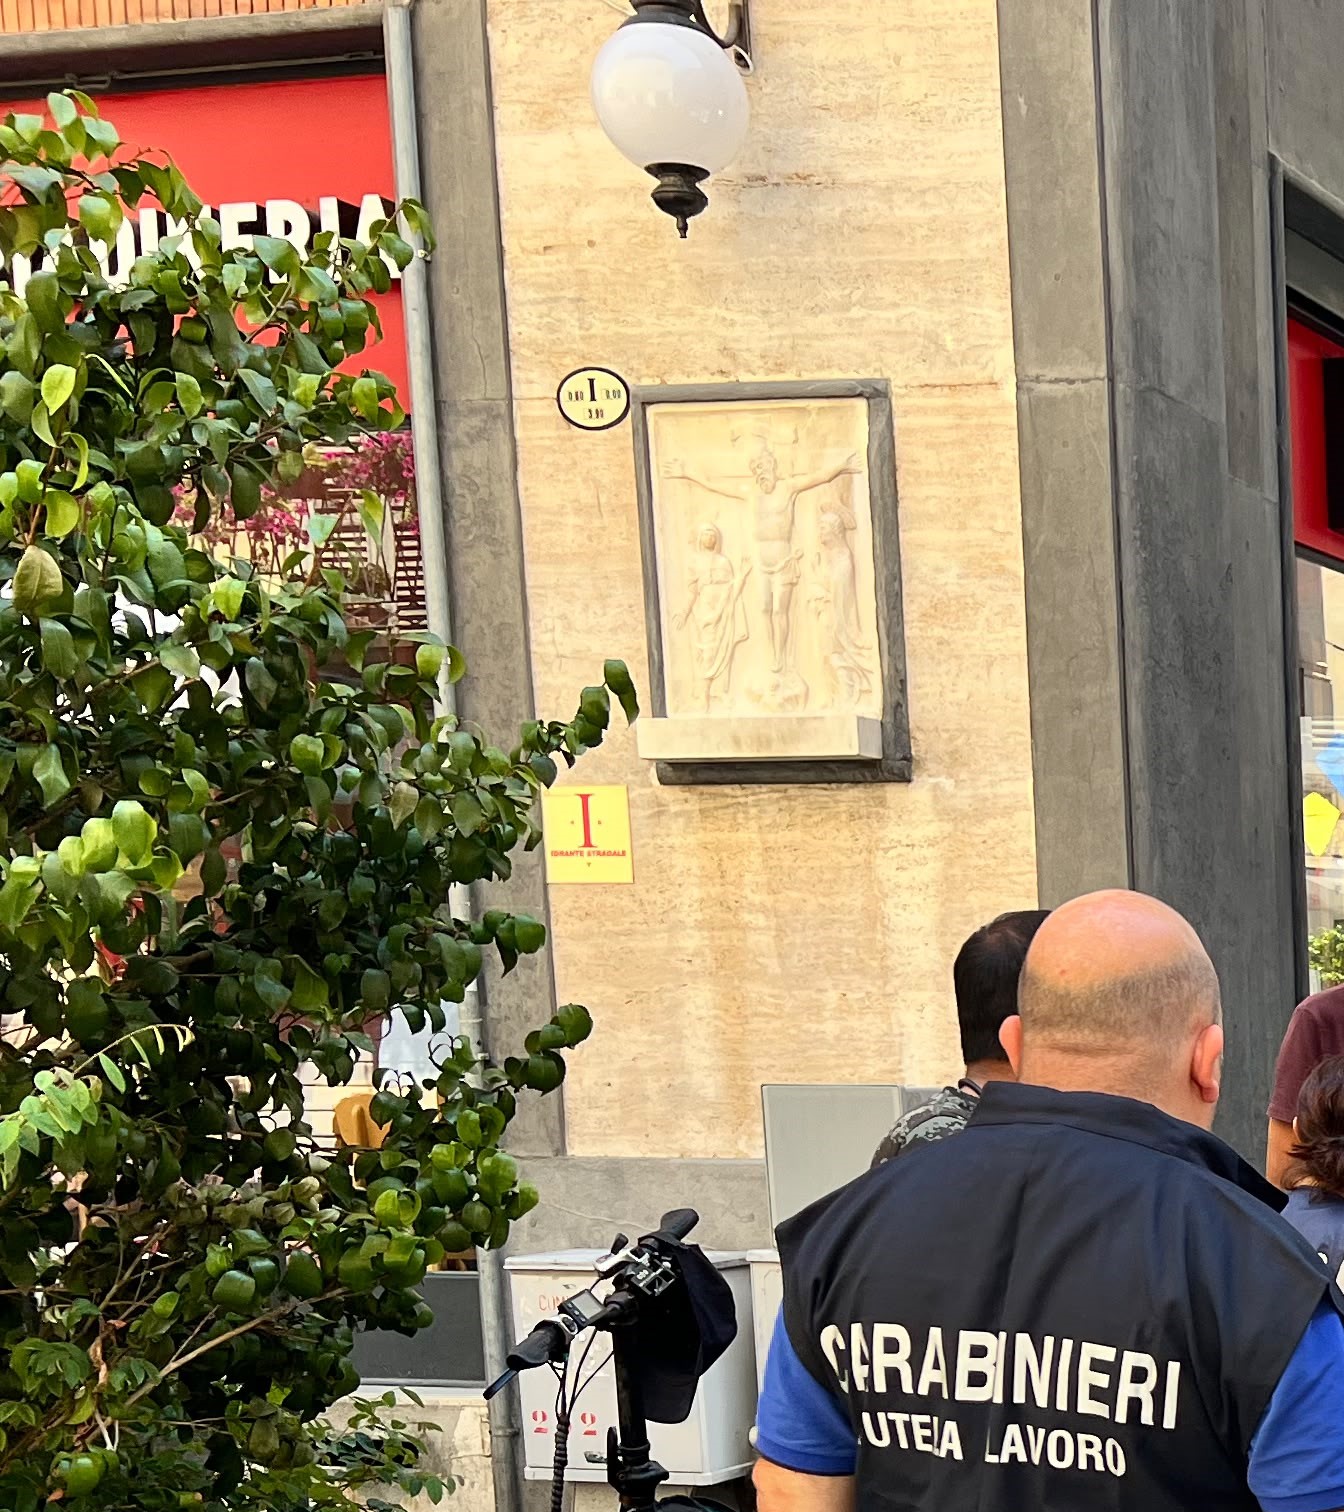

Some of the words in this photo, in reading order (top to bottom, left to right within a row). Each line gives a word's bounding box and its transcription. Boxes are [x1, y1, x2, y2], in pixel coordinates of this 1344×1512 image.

[587, 378, 597, 402] I
[575, 793, 597, 848] I
[820, 1322, 1181, 1430] CARABINIERI
[857, 1411, 964, 1461] UTELA
[984, 1422, 1127, 1478] LAVORO
